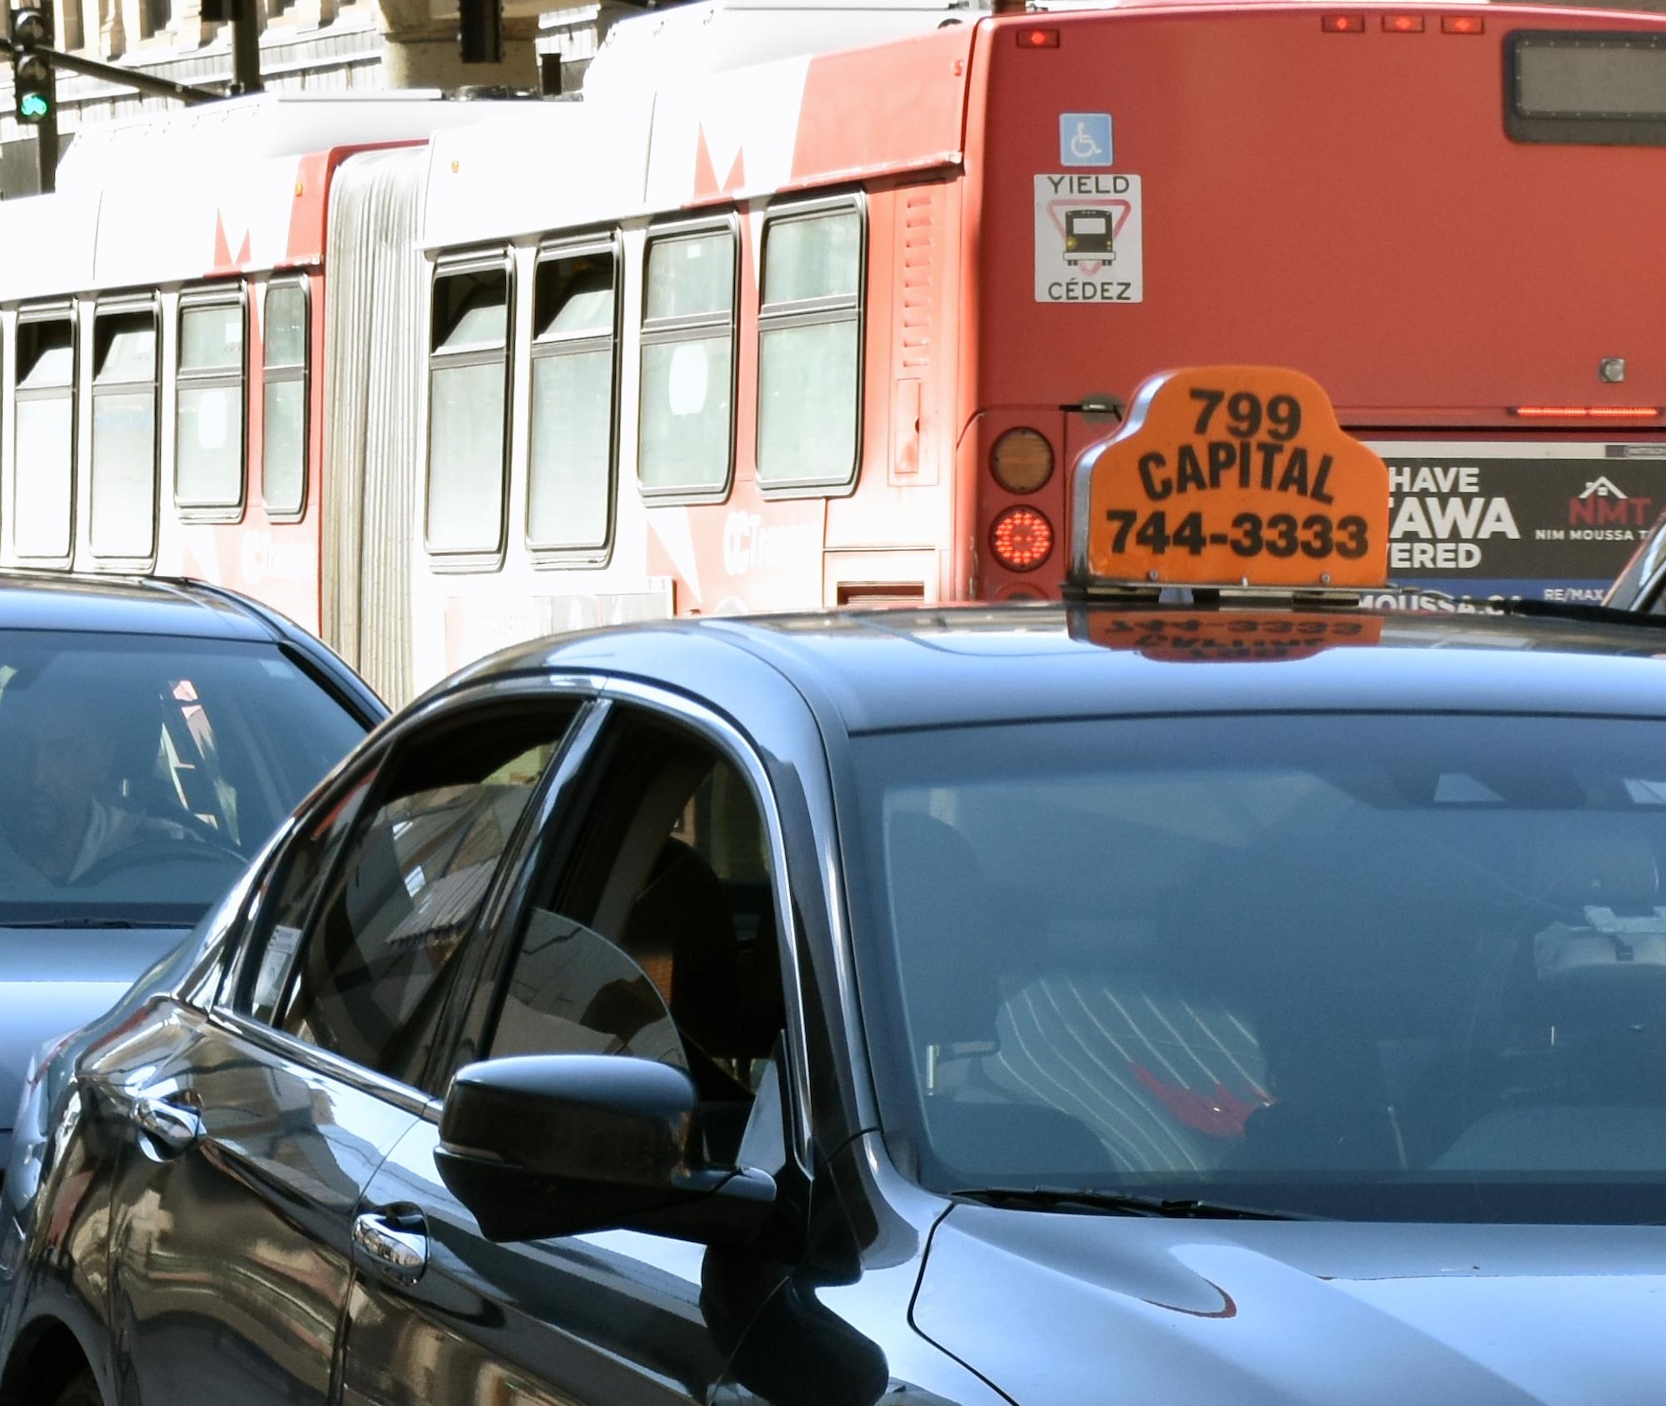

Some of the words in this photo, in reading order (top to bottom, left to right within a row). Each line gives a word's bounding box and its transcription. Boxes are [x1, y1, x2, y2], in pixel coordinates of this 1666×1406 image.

[1047, 175, 1130, 194] YIELD
[1047, 277, 1132, 301] CÉDEZ
[1189, 387, 1302, 442] 799
[1138, 441, 1334, 505] CAPITAL
[1389, 467, 1479, 492] HAVE
[1388, 497, 1521, 539] AWA
[1569, 495, 1652, 525] NMT
[1106, 510, 1369, 559] 744-3333
[1535, 530, 1565, 540] NIM
[1569, 530, 1635, 540] MOUSSA
[1387, 543, 1482, 568] ERED
[1544, 587, 1605, 602] RE/MAX
